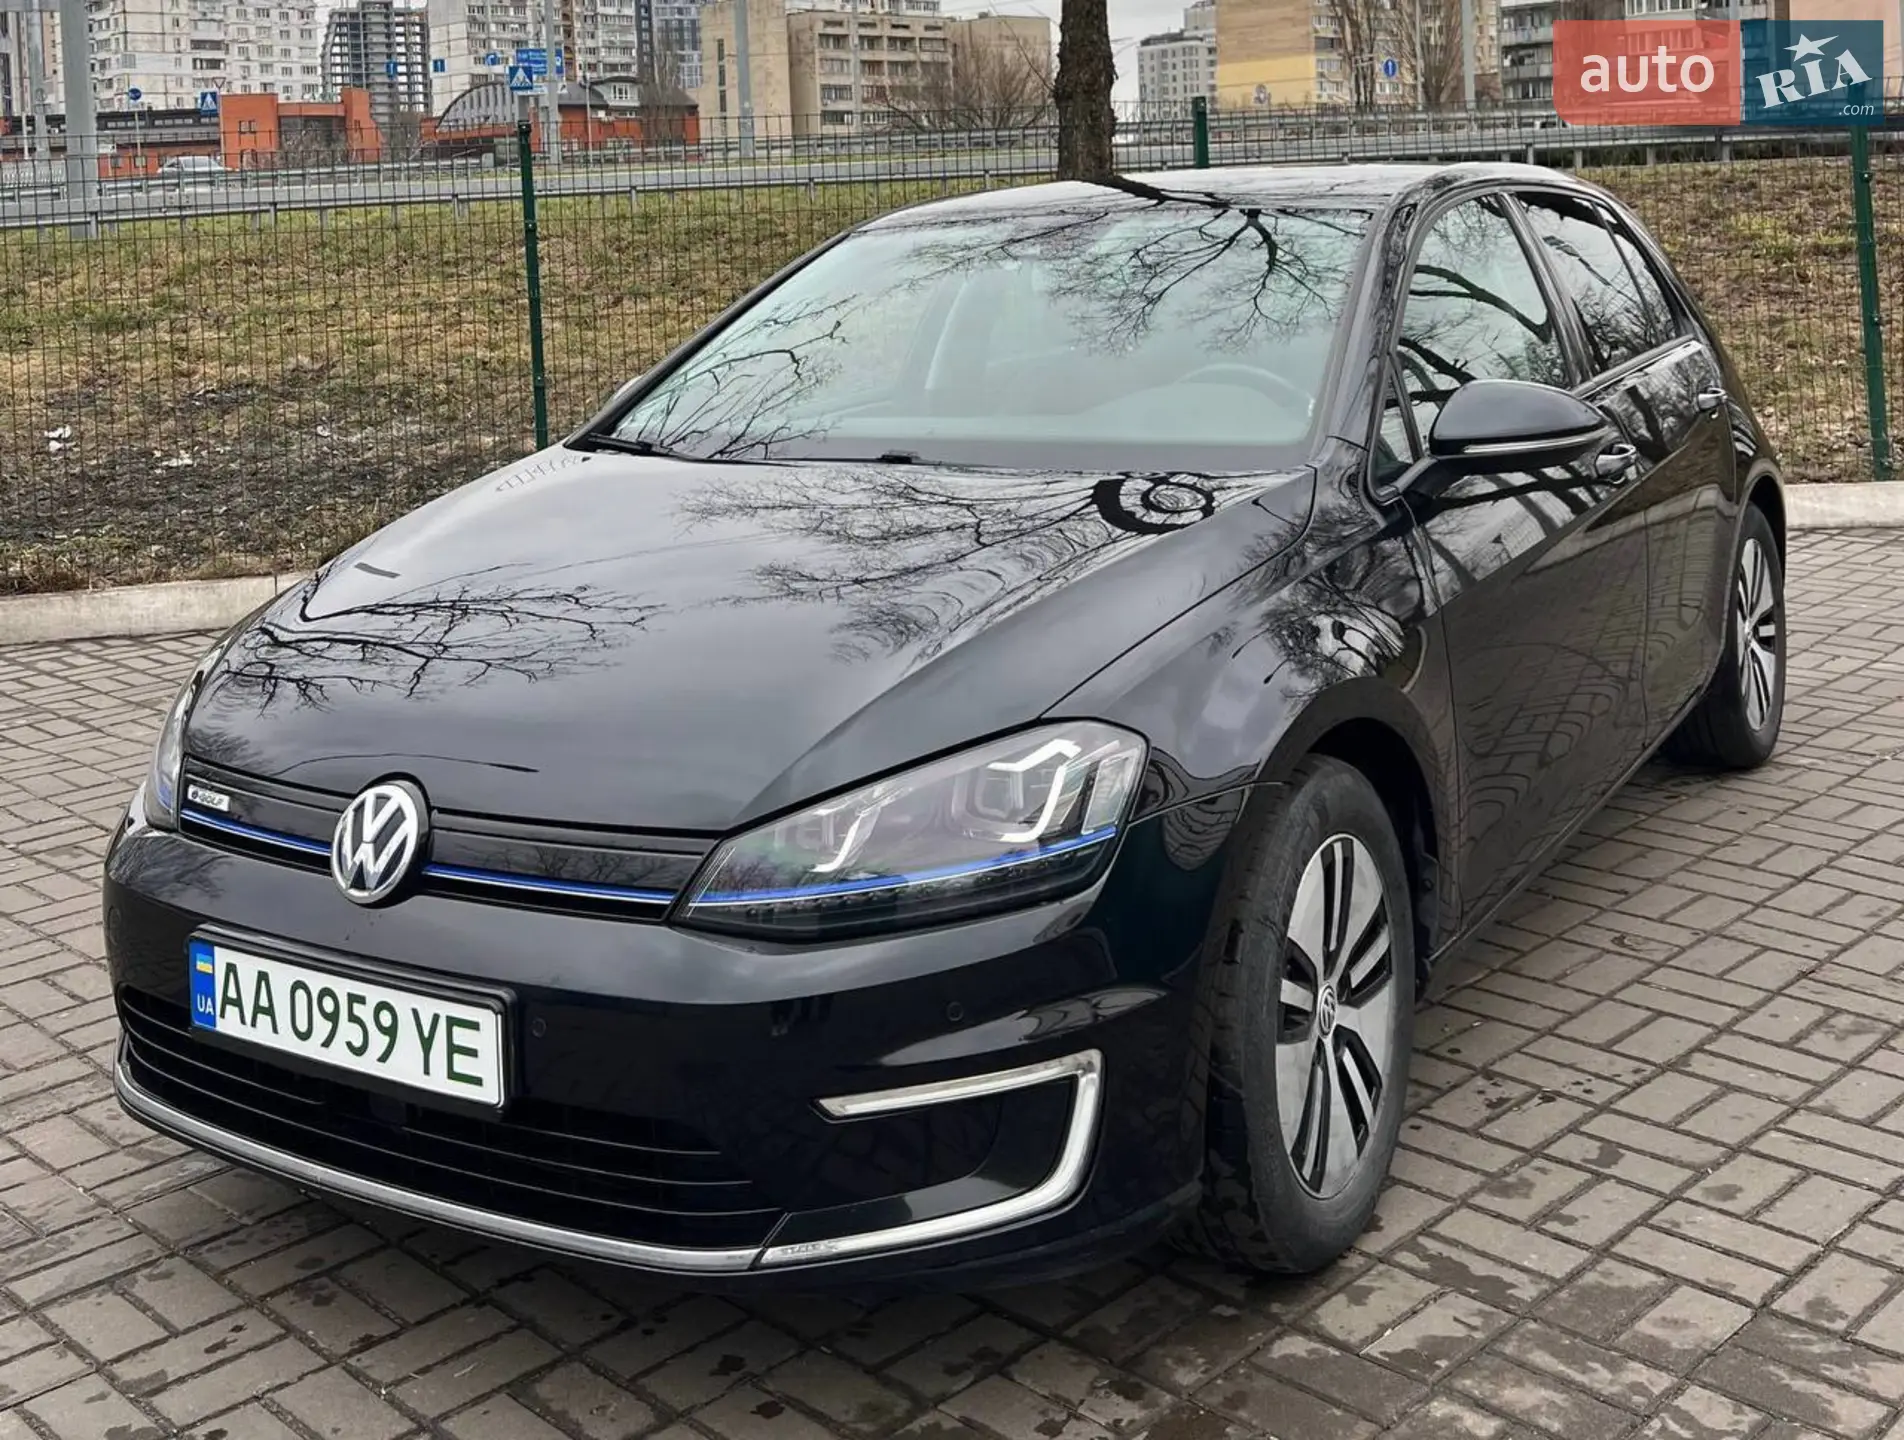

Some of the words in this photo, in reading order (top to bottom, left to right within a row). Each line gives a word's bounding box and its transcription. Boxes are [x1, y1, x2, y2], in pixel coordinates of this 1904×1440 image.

[196, 993, 215, 1016] UA
[220, 962, 279, 1034] AA
[289, 979, 399, 1063] 0959
[411, 1008, 483, 1086] YE
